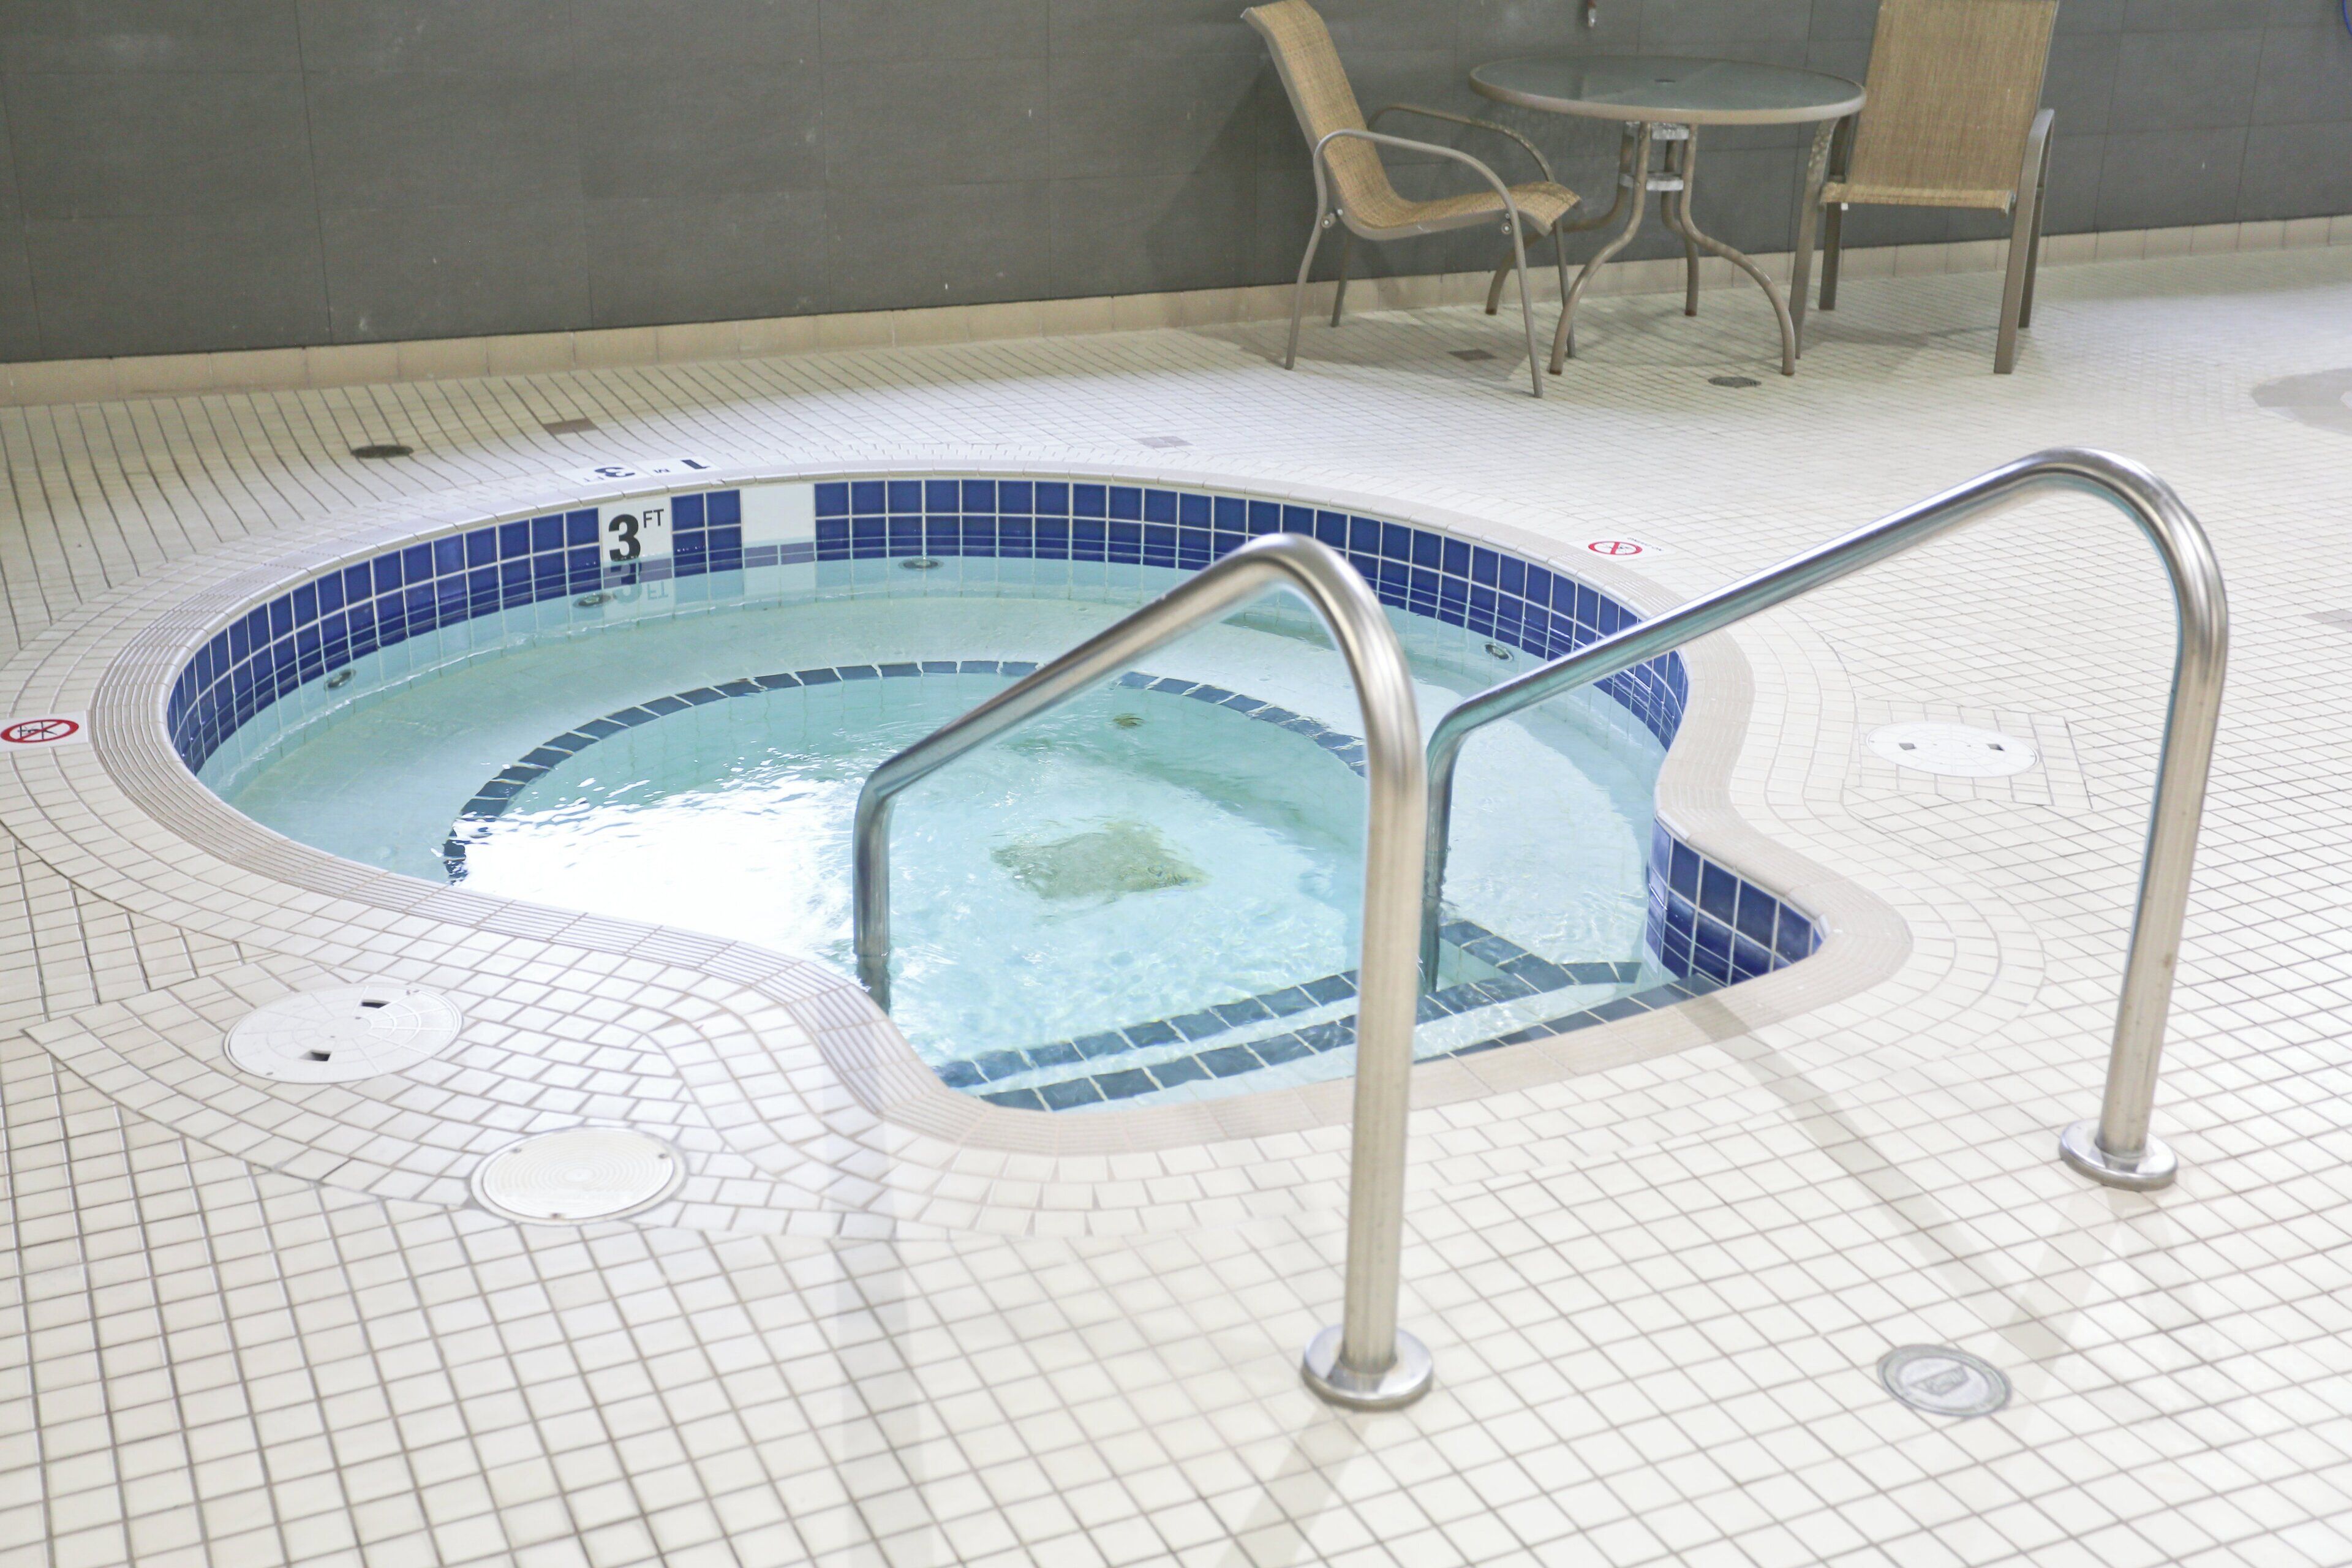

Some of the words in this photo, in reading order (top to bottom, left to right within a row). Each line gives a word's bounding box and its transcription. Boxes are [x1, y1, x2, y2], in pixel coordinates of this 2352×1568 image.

[681, 459, 710, 470] 1
[594, 467, 635, 478] 3
[609, 514, 641, 562] 3
[643, 508, 664, 529] FT
